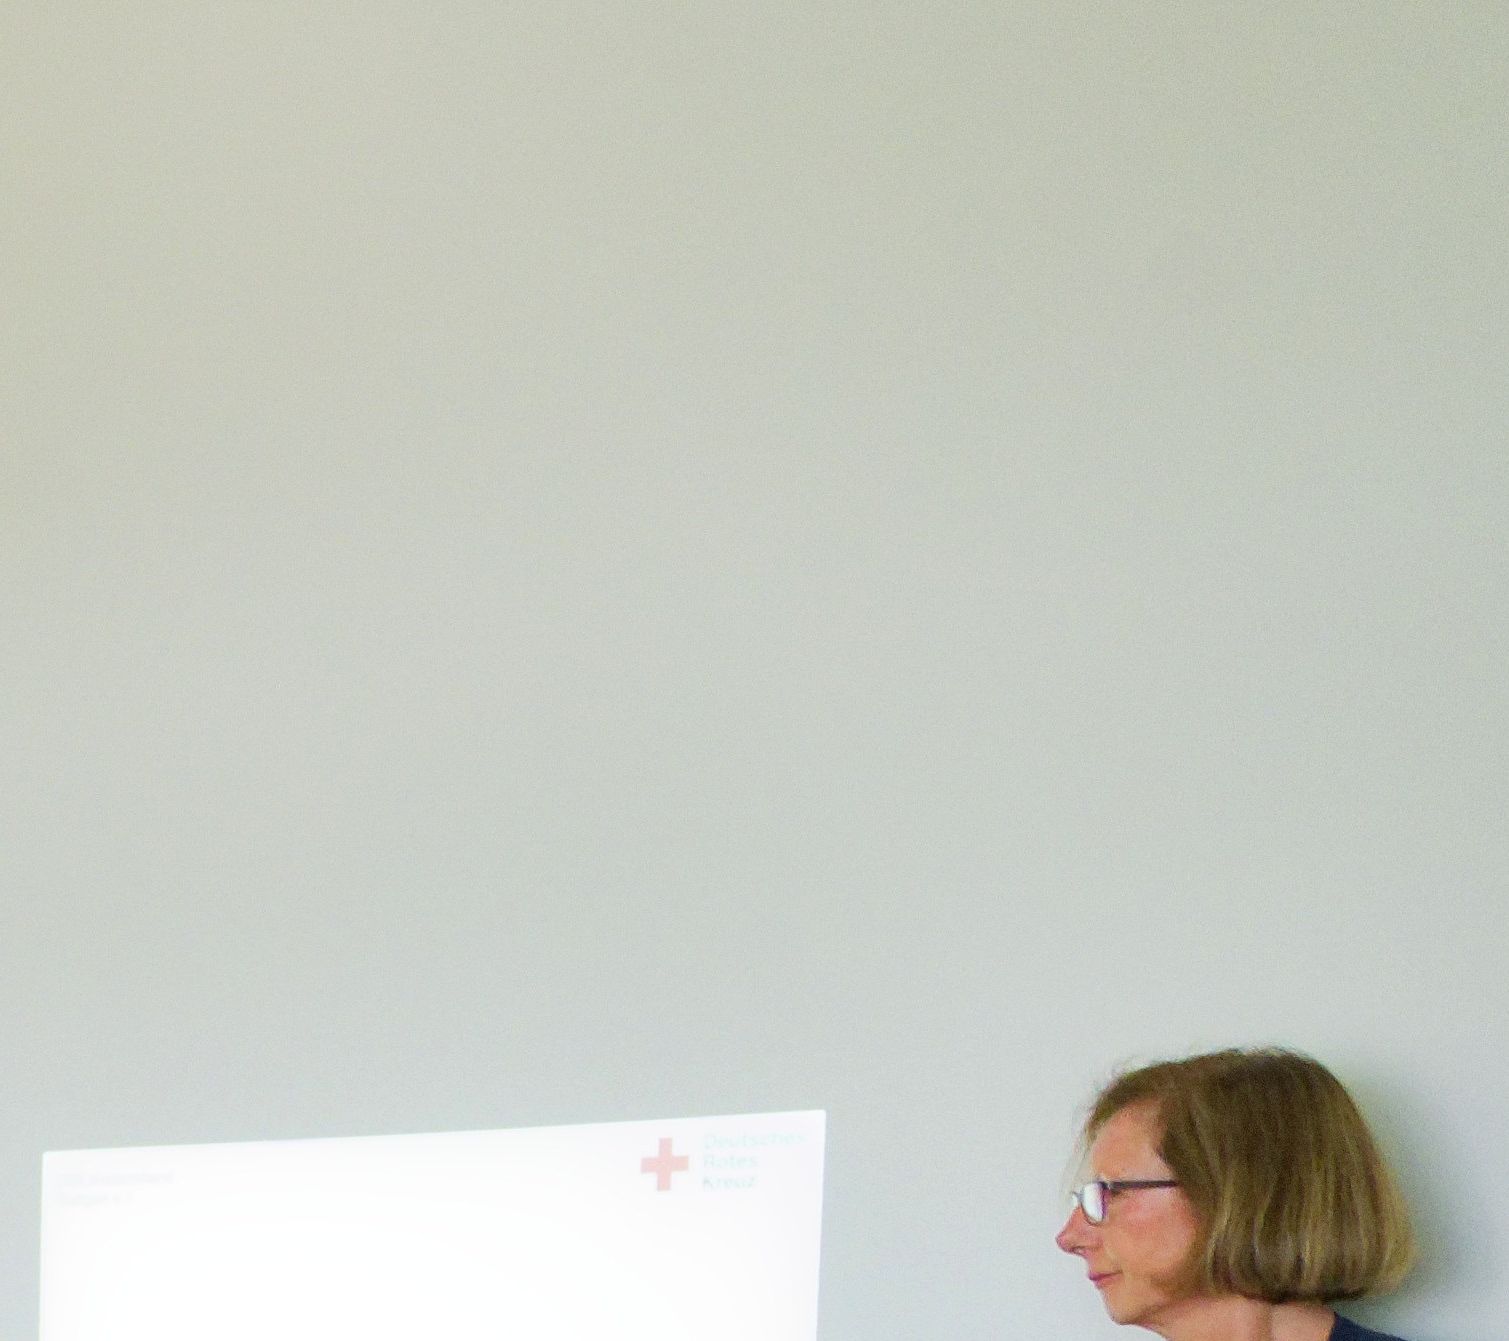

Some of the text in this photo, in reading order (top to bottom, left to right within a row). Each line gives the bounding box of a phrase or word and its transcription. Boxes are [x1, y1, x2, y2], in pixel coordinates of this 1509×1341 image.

[703, 1132, 806, 1150] Deutsches
[703, 1154, 759, 1169] Rotes
[702, 1175, 757, 1190] Kreuz
